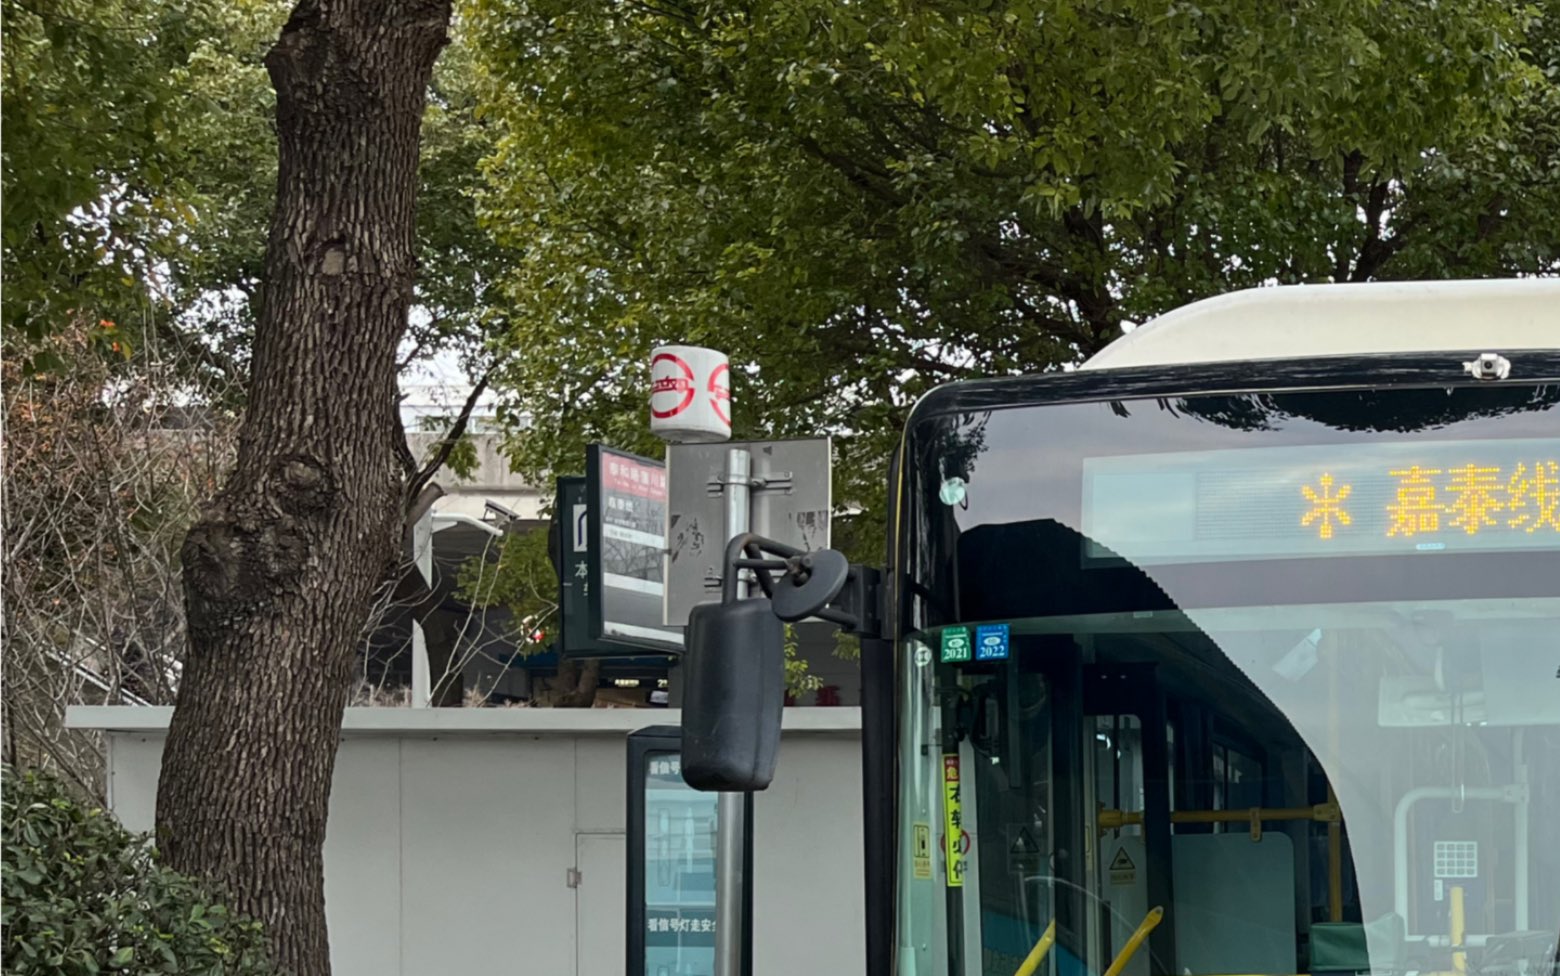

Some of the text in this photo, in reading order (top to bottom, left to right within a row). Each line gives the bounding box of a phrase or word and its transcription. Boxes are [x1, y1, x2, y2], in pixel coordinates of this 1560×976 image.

[944, 647, 967, 660] 2021
[980, 645, 1005, 658] 2022
[648, 918, 715, 932] 看信号灯走安
